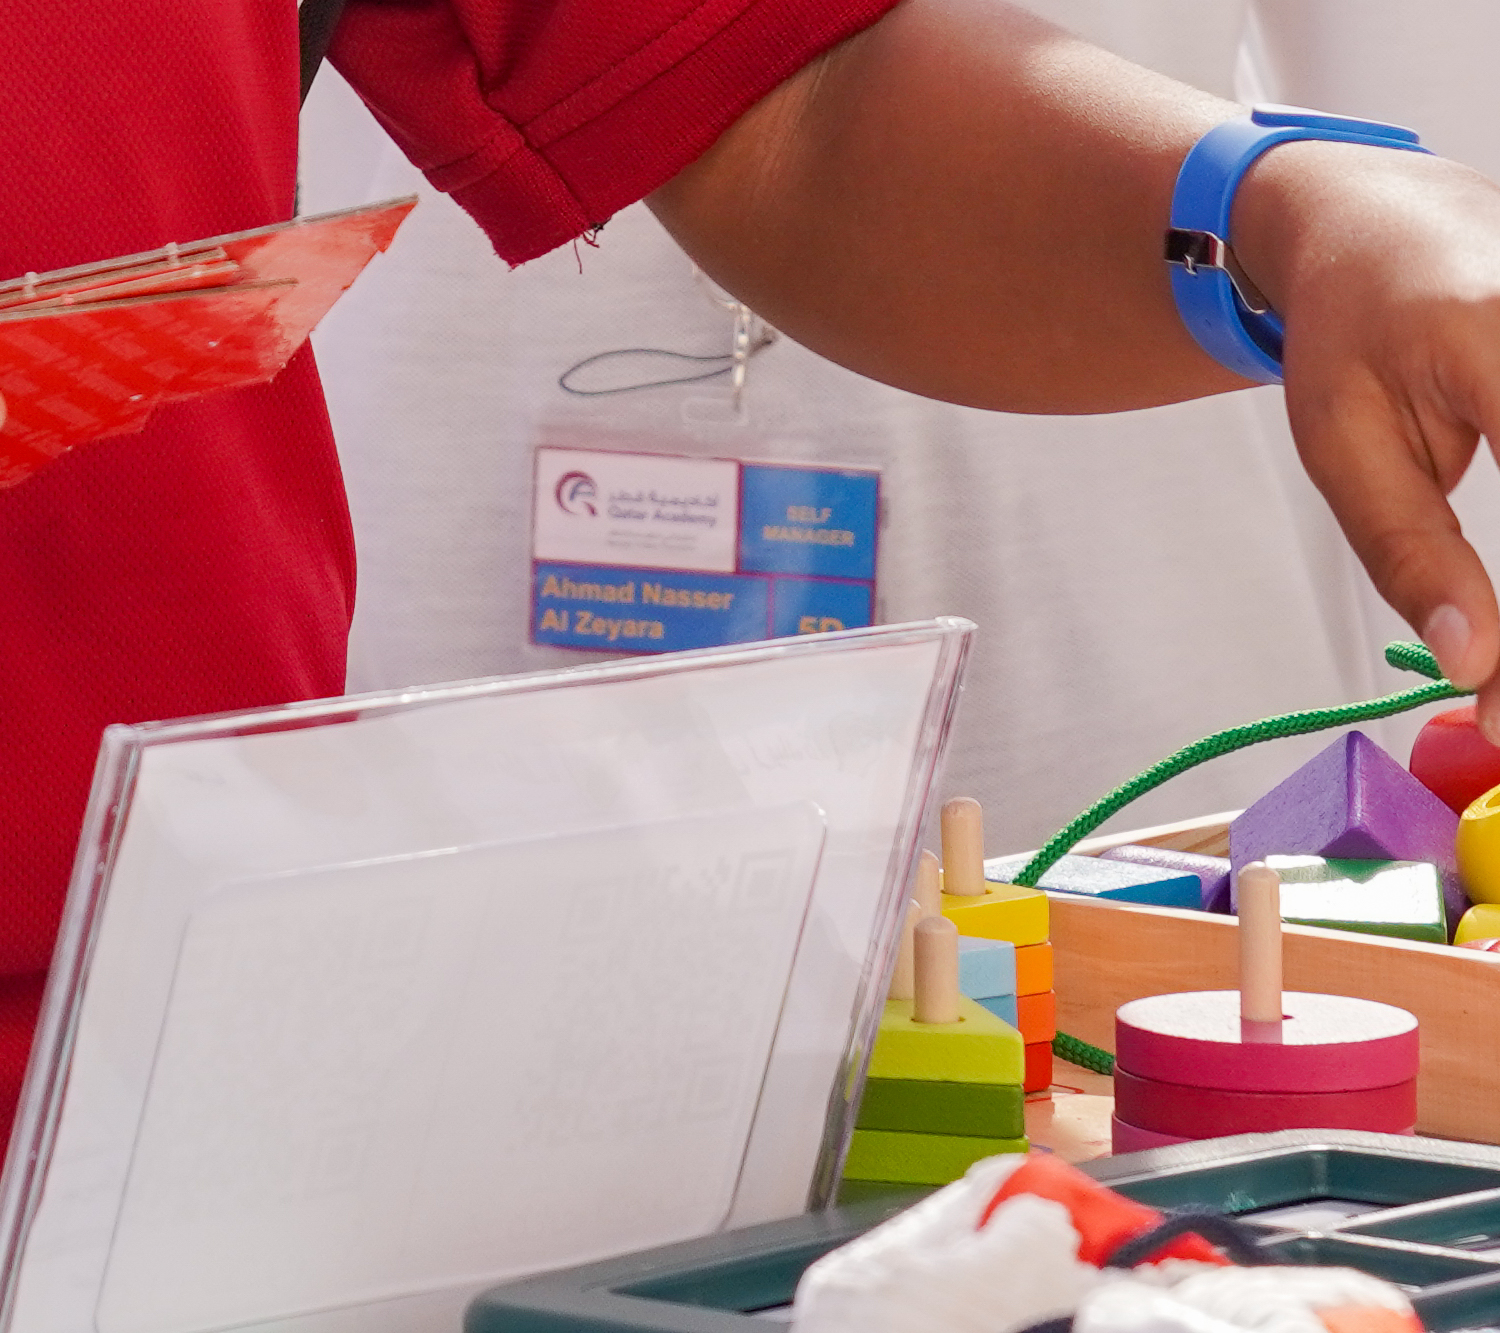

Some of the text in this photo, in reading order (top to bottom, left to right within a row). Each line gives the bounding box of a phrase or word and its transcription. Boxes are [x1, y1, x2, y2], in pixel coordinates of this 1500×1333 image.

[541, 574, 735, 610] Ahmad Nasser
[540, 608, 665, 642] Al Zeyara
